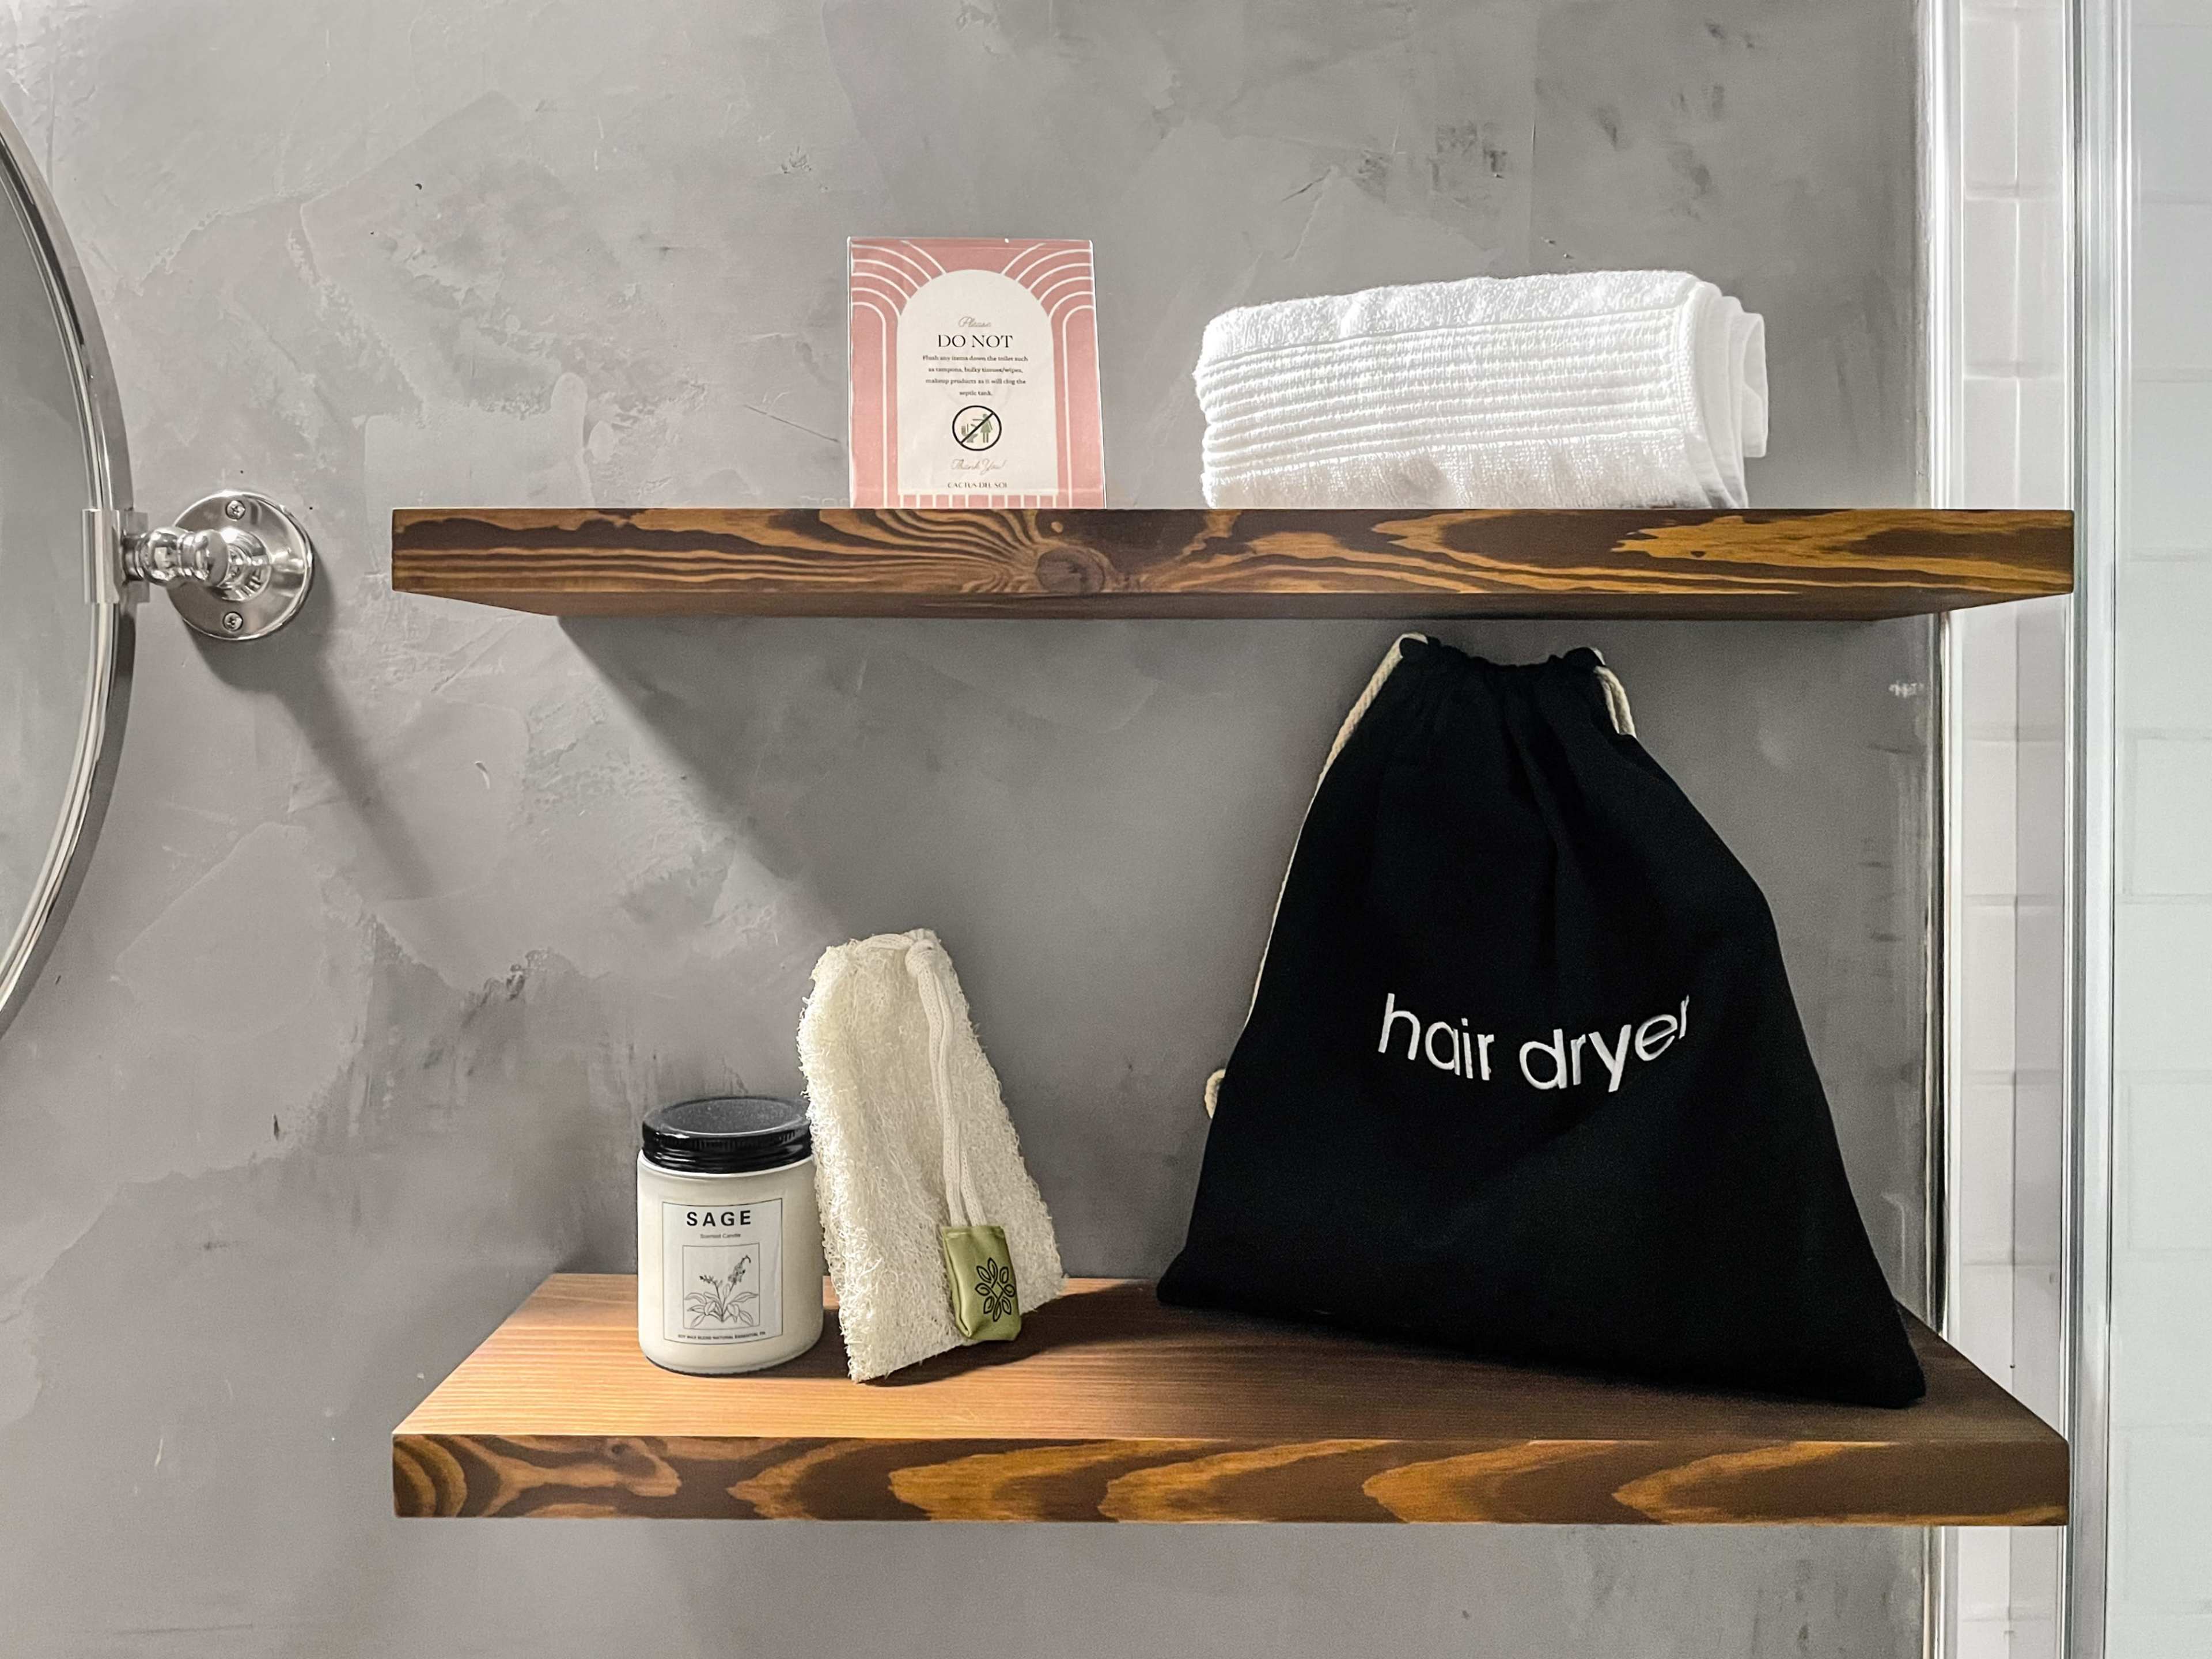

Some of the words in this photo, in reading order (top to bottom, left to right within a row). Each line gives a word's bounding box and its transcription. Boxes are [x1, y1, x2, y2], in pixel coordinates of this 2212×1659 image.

[959, 316, 991, 327] Please
[938, 334, 966, 348] DO
[972, 335, 1013, 348] NOT
[951, 459, 980, 470] Thank
[1378, 993, 1495, 1081] hair
[1519, 994, 1690, 1093] dryer
[686, 1210, 751, 1227] SAGE
